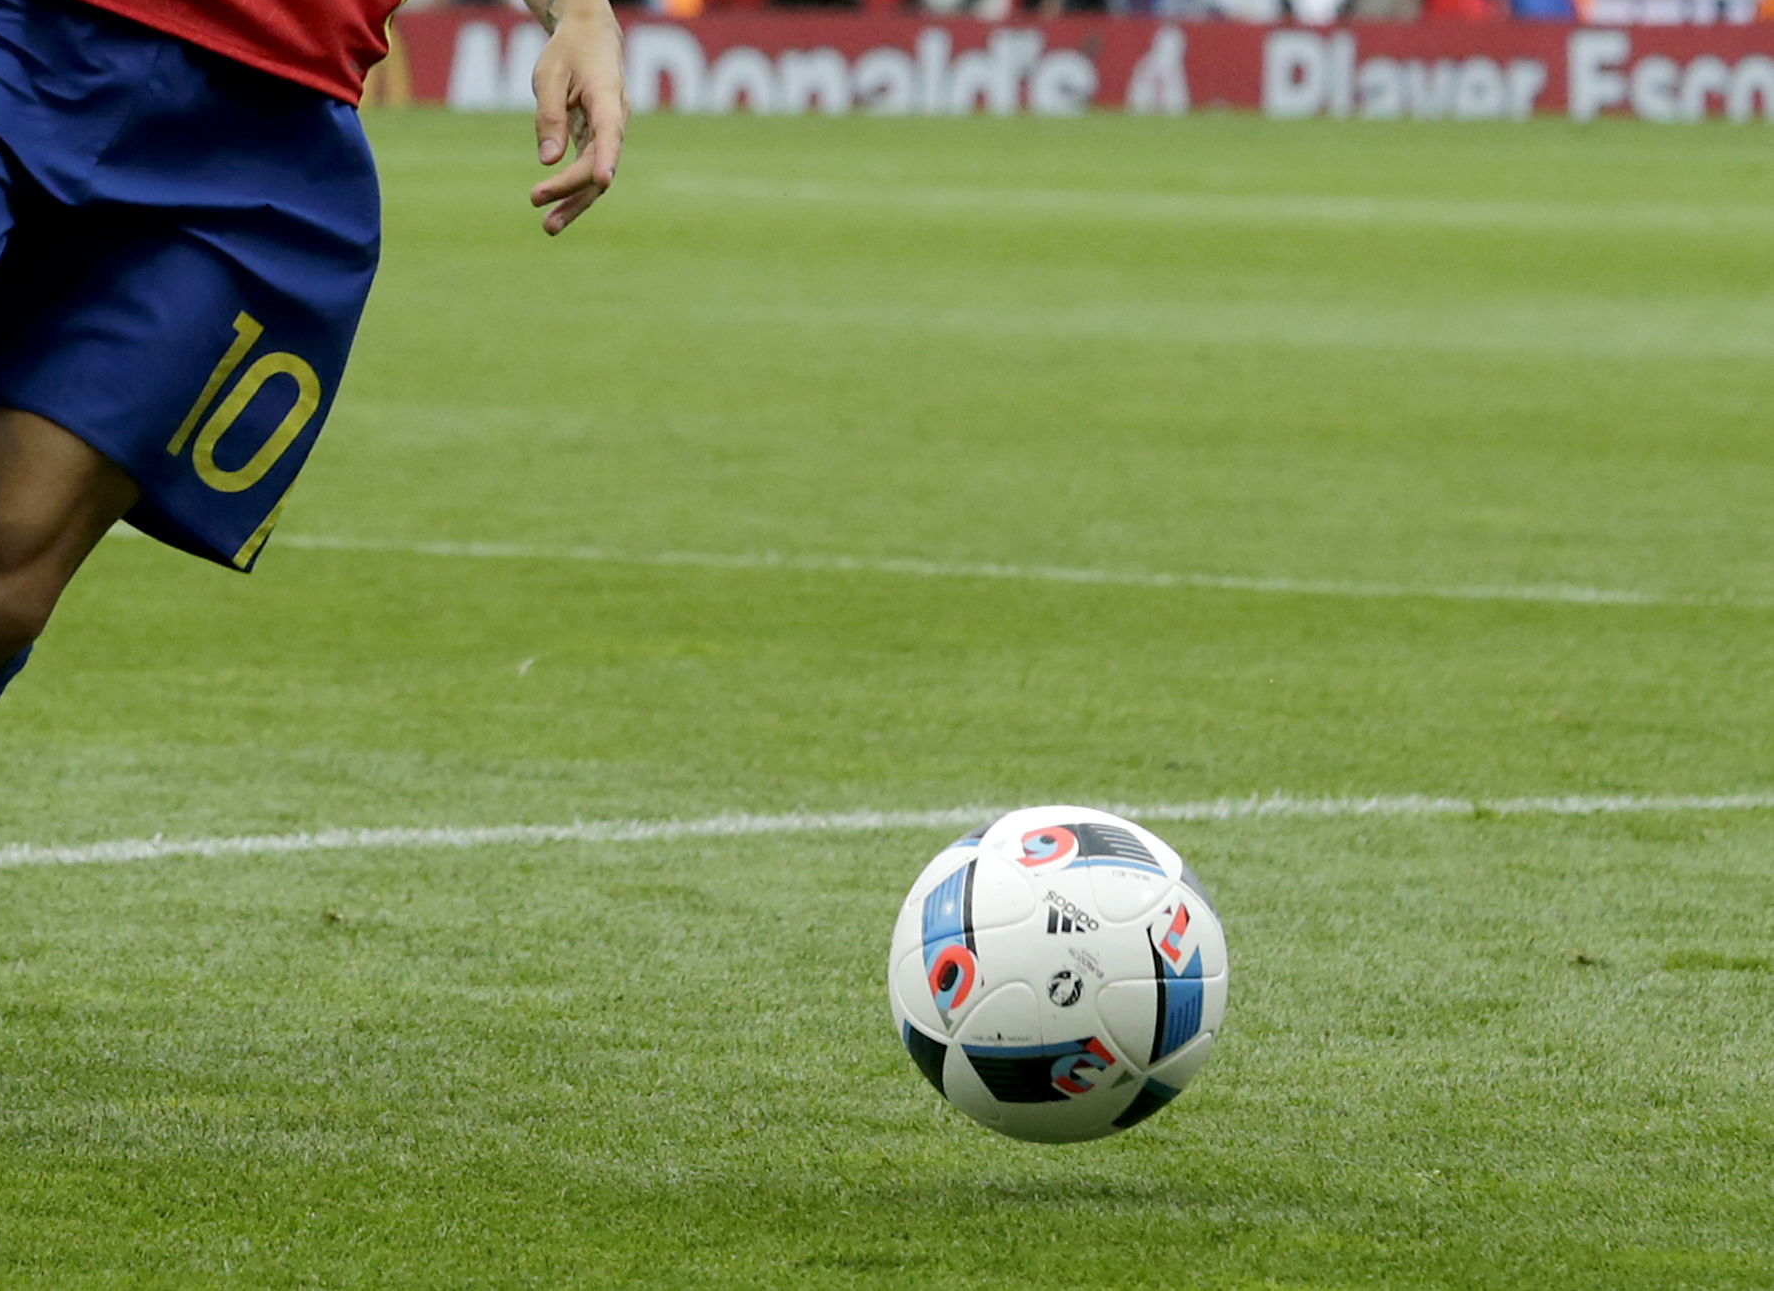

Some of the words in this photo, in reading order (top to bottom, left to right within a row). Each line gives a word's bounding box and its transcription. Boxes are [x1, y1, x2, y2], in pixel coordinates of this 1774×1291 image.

[446, 21, 1099, 117] MDonald's
[166, 310, 322, 493] 10
[1045, 890, 1100, 931] adidas
